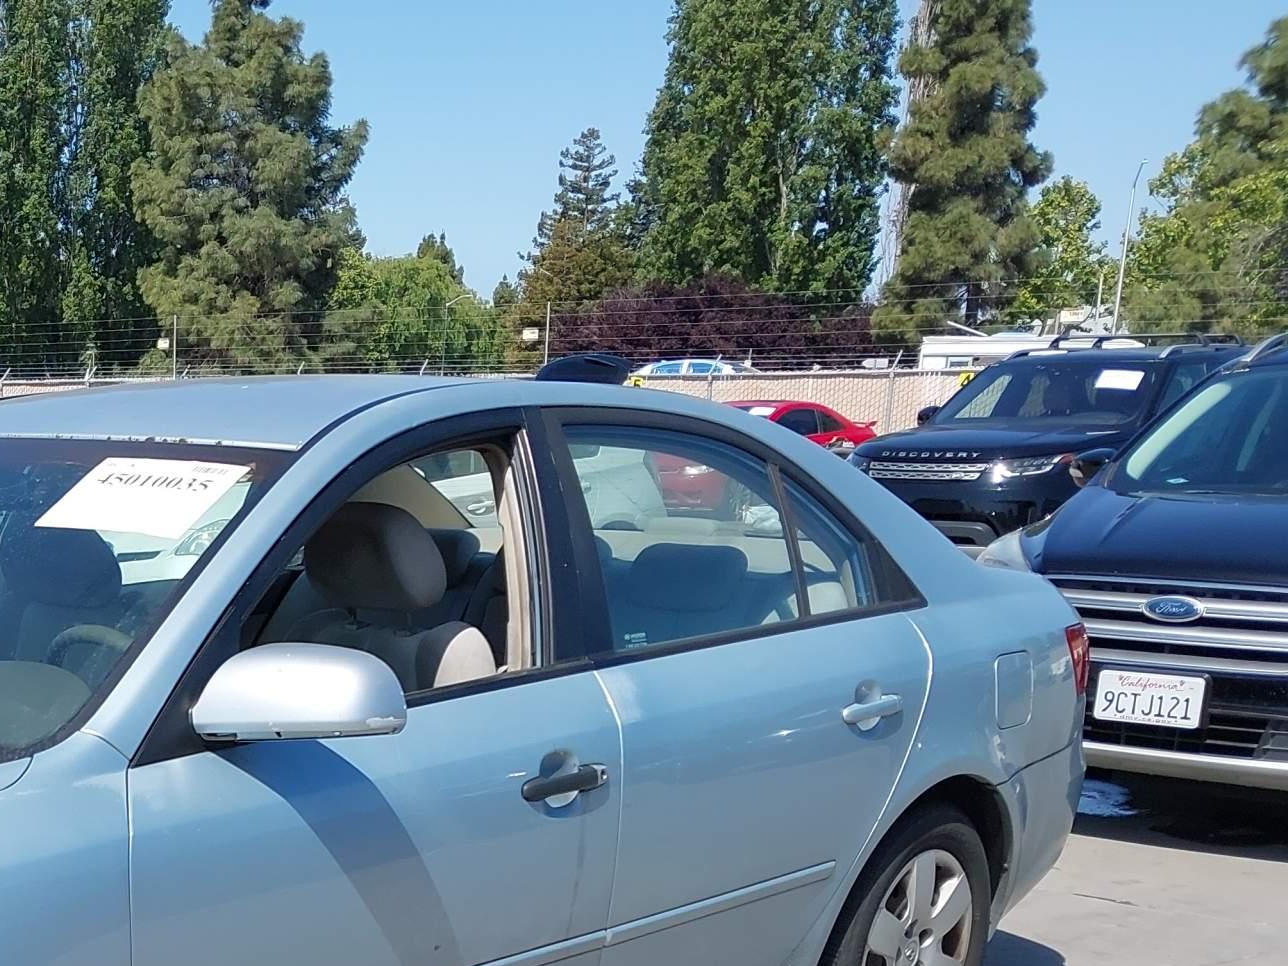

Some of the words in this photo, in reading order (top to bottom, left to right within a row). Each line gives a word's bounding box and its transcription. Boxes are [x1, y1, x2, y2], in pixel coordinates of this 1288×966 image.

[881, 450, 982, 458] DISCOVERY
[98, 472, 214, 491] 45010035
[1155, 601, 1188, 613] Ford
[1120, 675, 1179, 692] California
[1101, 690, 1192, 721] 9CTJ121
